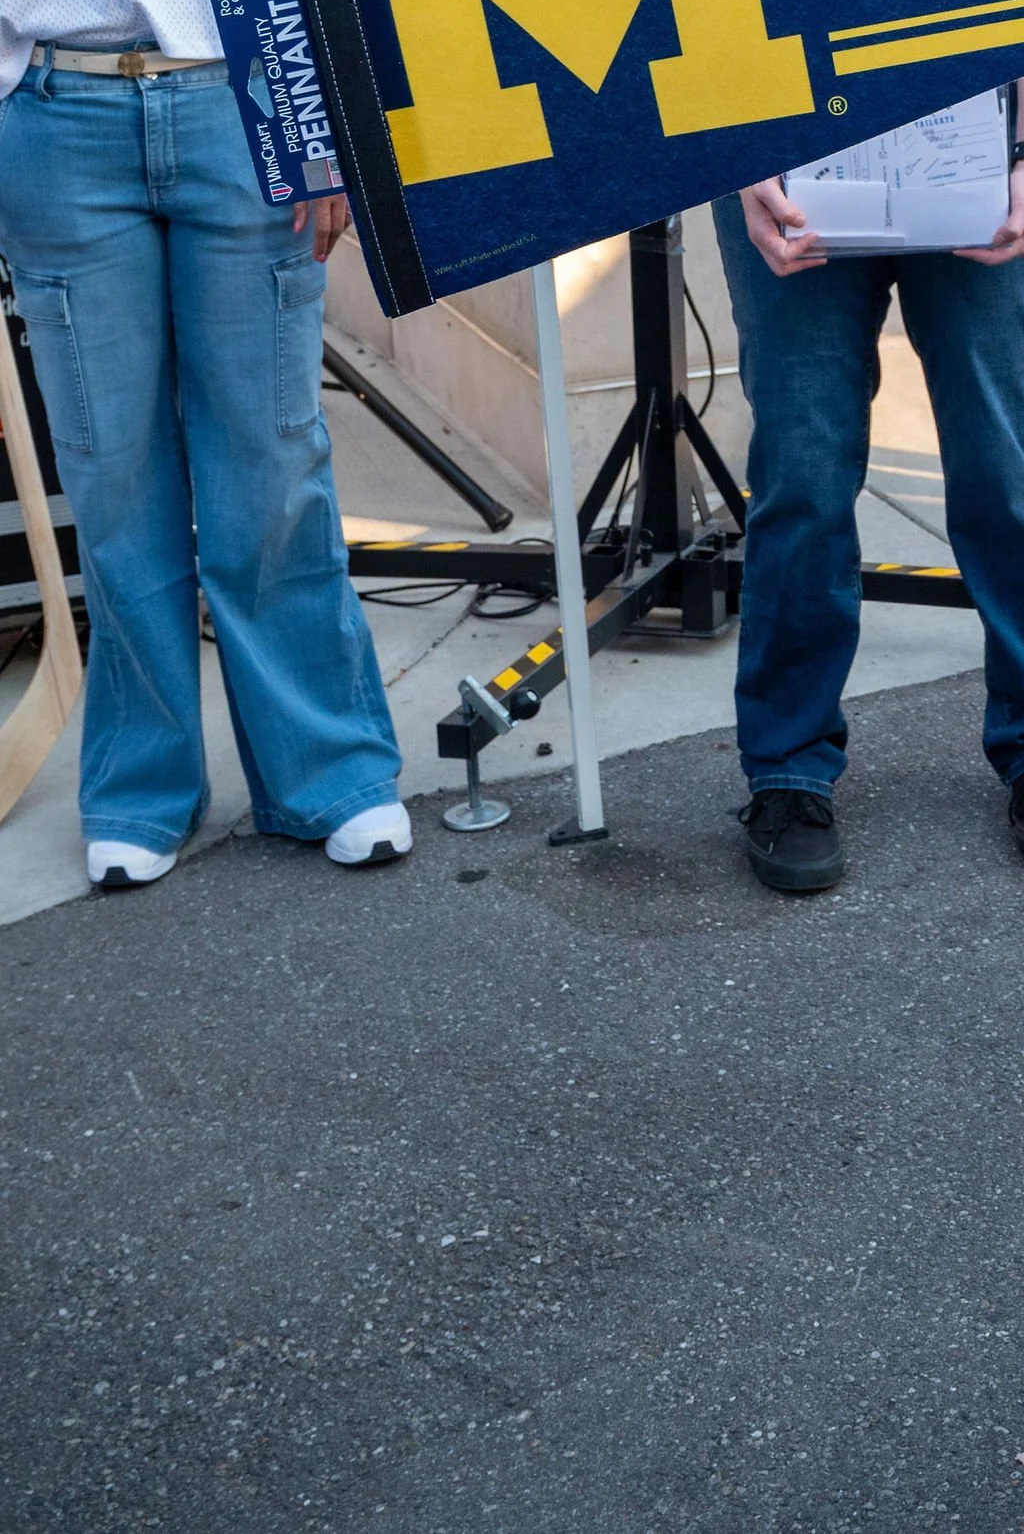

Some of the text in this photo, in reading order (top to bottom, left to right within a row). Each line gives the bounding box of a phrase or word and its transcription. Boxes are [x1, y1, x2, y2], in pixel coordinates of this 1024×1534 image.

[233, 5, 245, 16] &
[254, 17, 302, 153] PREMIUM QUALITY
[268, 0, 337, 161] PENNANT
